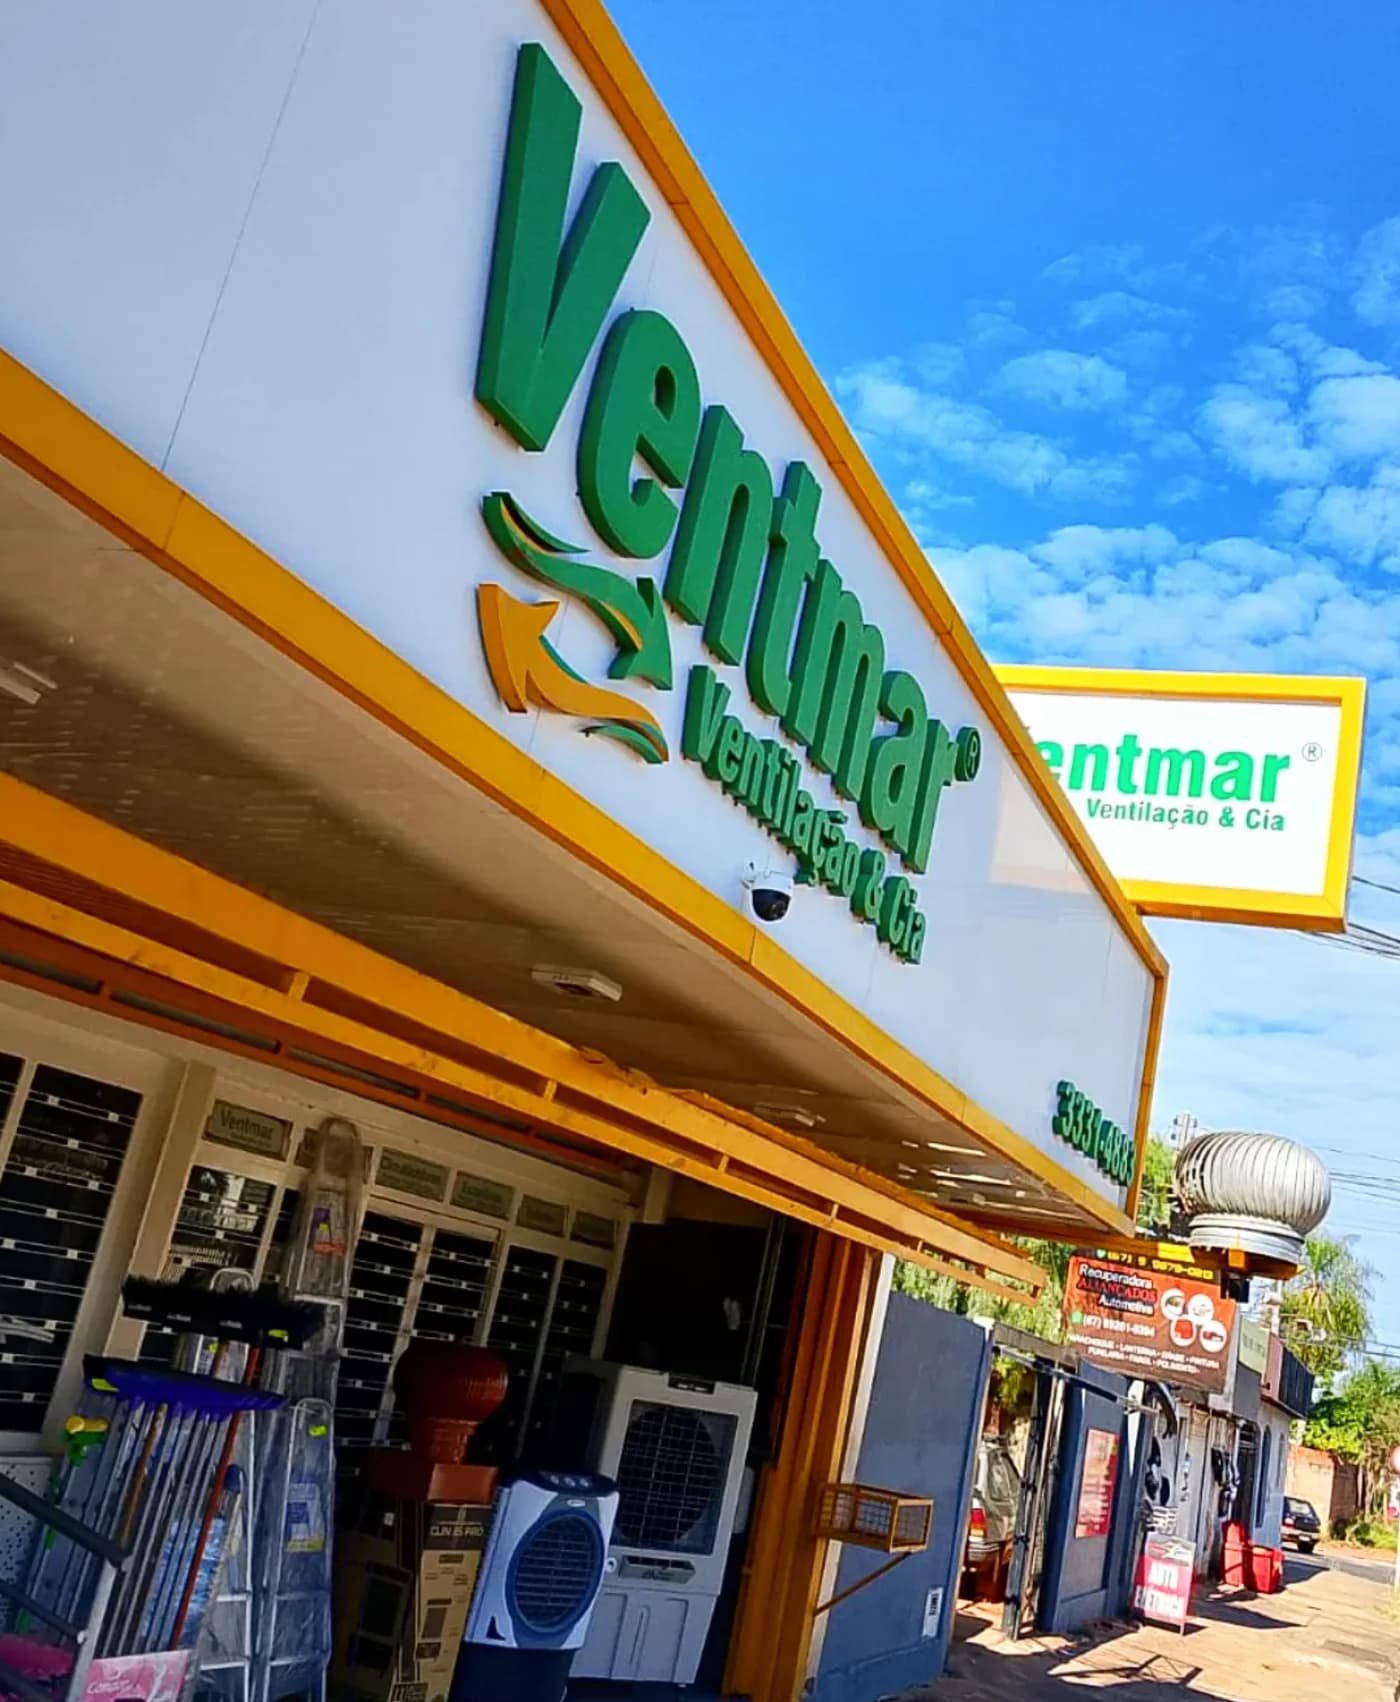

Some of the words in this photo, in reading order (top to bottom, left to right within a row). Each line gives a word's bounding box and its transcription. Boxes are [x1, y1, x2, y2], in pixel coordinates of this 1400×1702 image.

[475, 43, 959, 874] Ventmar
[1033, 734, 1291, 803] entmar
[681, 664, 859, 897] Ventilação
[851, 849, 886, 923] &
[876, 876, 926, 965] Cia
[1086, 798, 1209, 830] Ventilação
[1218, 806, 1236, 828] &
[1245, 808, 1285, 831] Cia
[1079, 1262, 1153, 1290] Recuperadora
